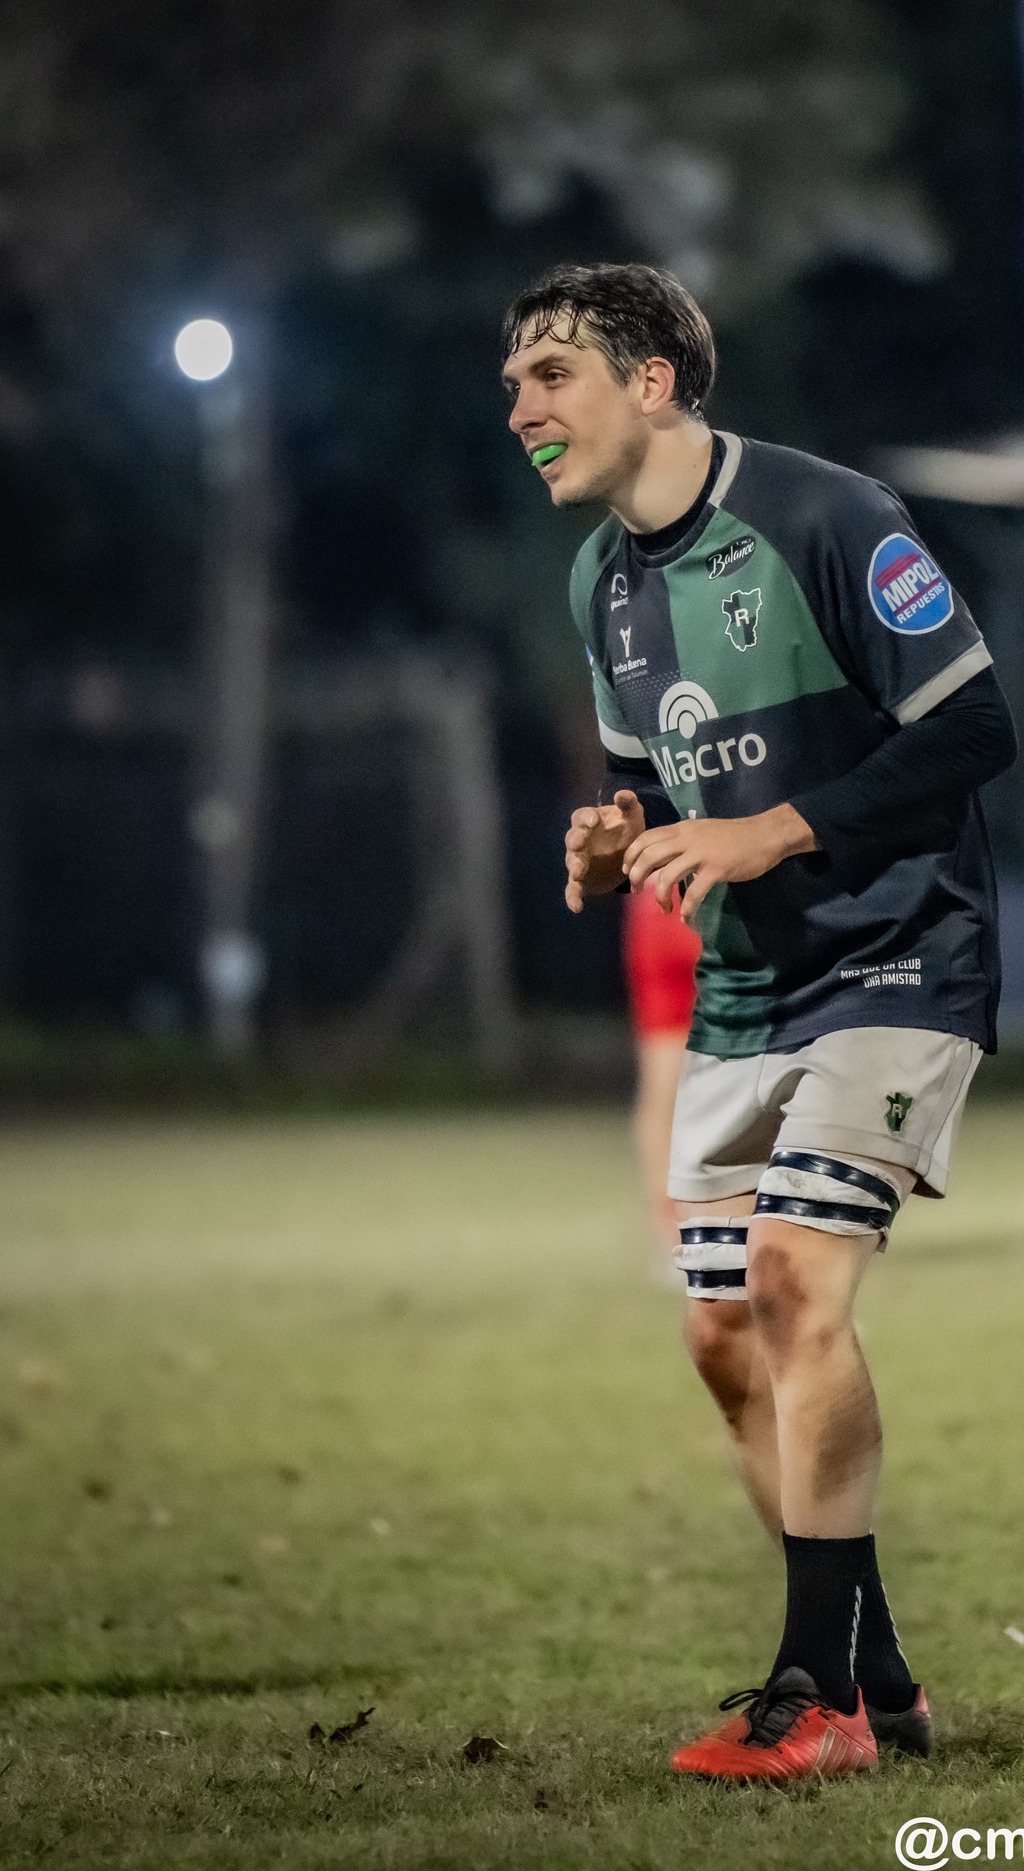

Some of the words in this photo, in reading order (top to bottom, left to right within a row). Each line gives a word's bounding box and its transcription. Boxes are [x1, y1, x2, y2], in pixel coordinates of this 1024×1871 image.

[709, 542, 755, 580] Balance
[881, 558, 939, 613] MIPOL
[734, 607, 750, 628] R
[651, 733, 767, 789] Macro
[898, 958, 921, 970] CLUB
[863, 975, 881, 988] UNA
[882, 973, 921, 986] AMISTAD
